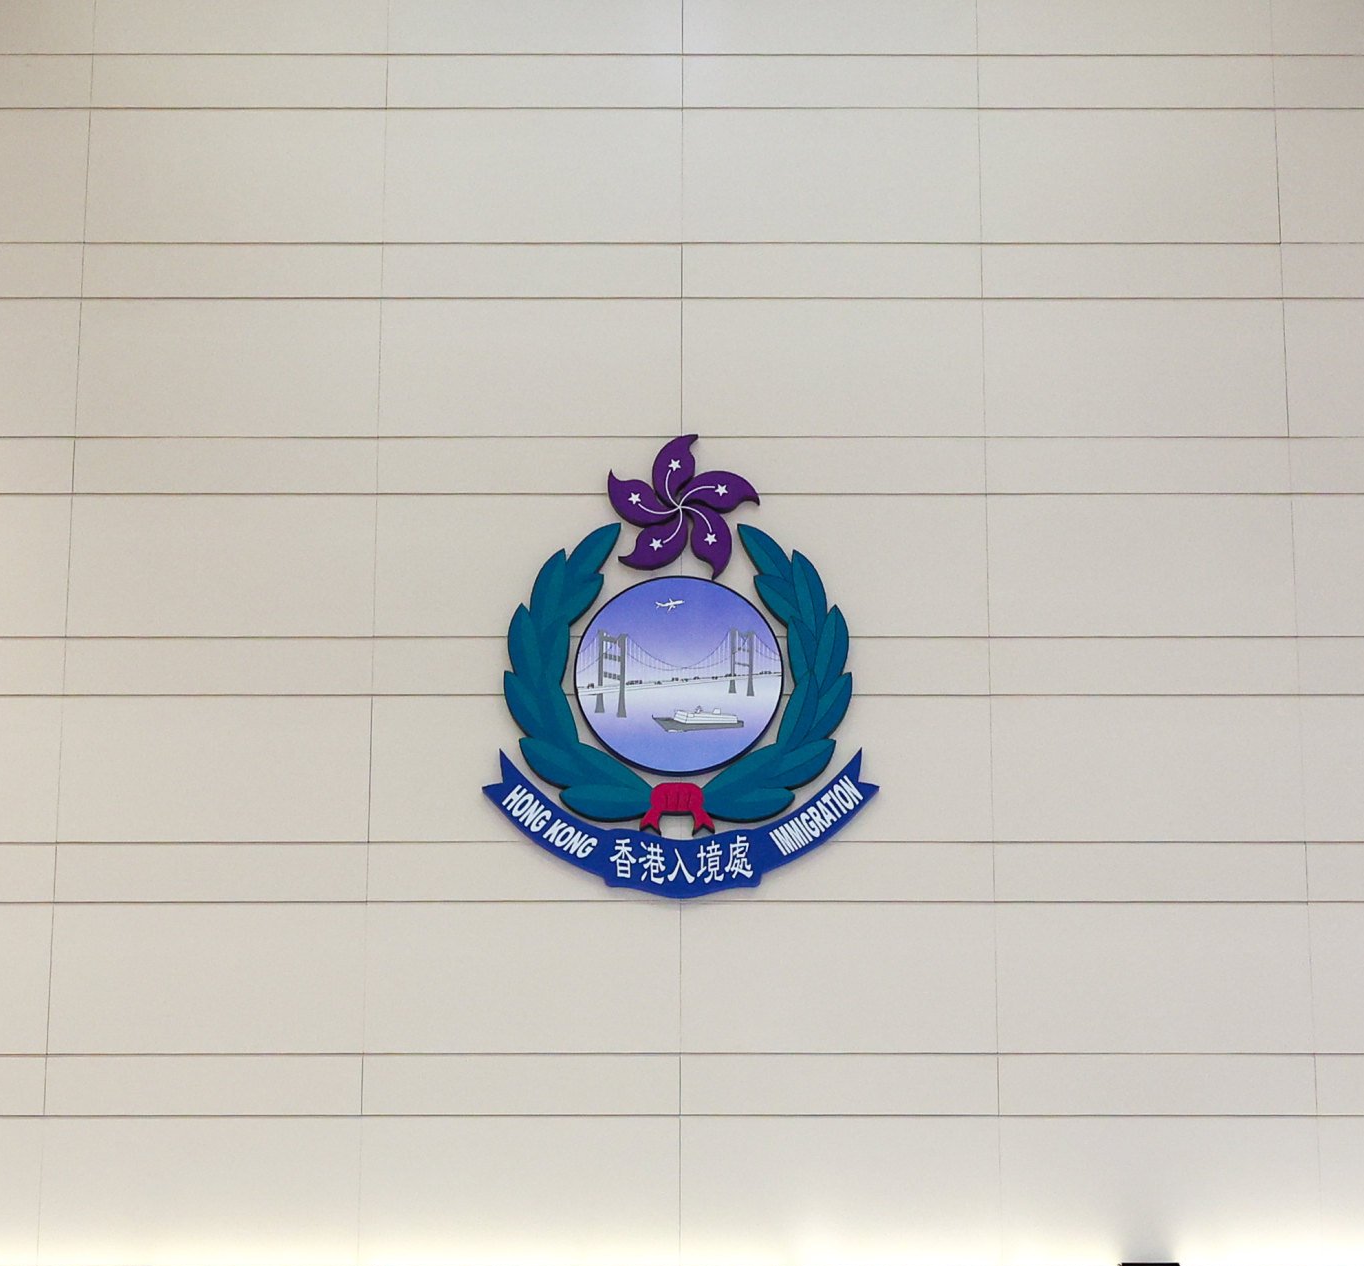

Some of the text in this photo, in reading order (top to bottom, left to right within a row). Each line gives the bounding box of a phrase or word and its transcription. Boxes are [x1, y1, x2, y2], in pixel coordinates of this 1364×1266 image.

[501, 783, 599, 859] HONG KONG
[768, 775, 864, 857] IMMIGRATION
[609, 834, 755, 884] 香港入境處
